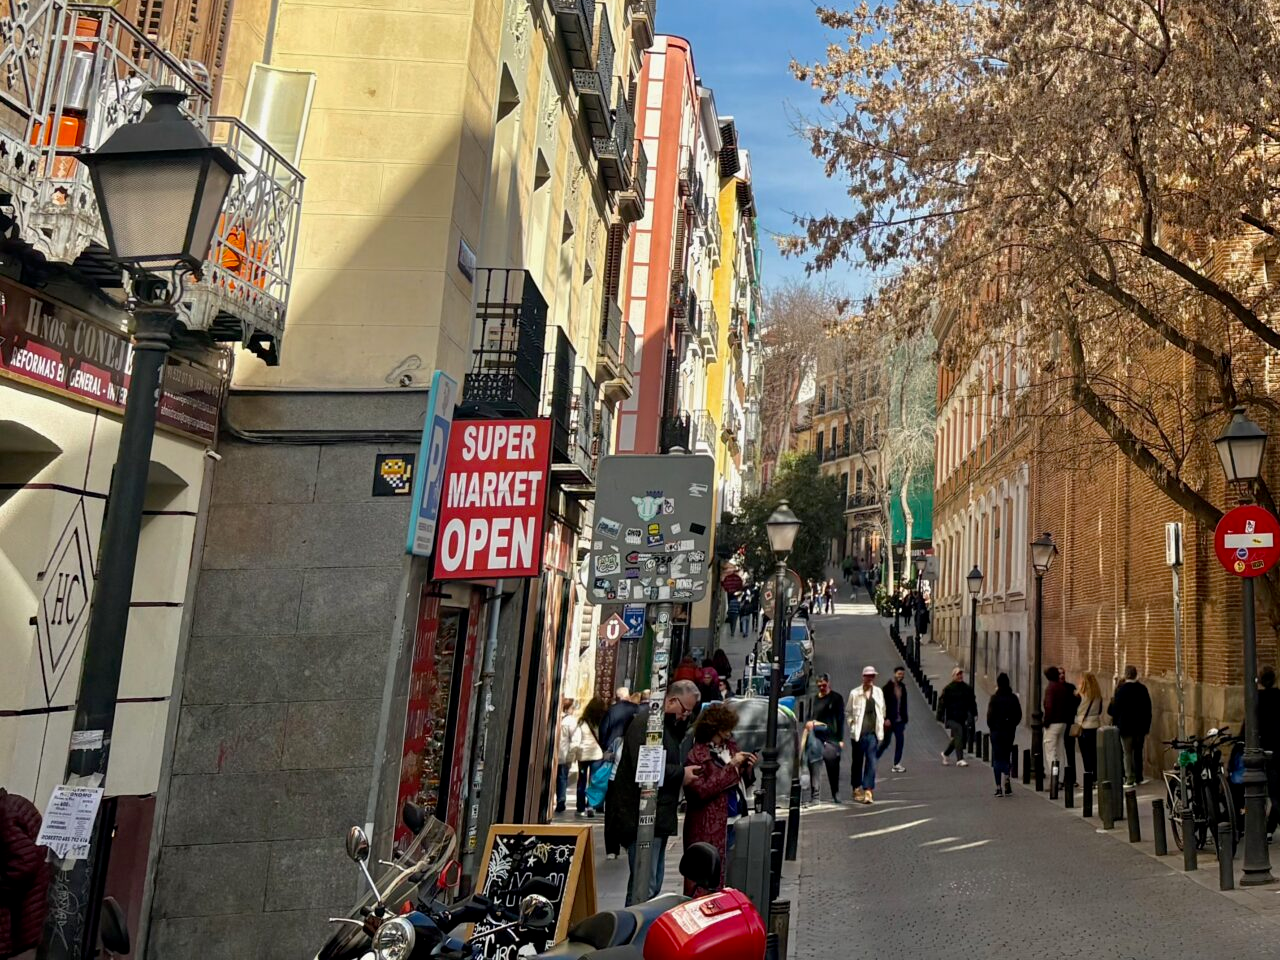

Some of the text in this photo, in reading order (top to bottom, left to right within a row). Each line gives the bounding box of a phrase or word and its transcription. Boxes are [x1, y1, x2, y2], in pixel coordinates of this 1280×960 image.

[10, 346, 56, 380] REFORMAS
[56, 363, 68, 383] EN
[70, 368, 101, 395] GENERAL
[422, 424, 444, 509] P
[462, 425, 536, 461] SUPER
[447, 471, 542, 508] MARKET
[441, 517, 536, 571] OPEN
[51, 573, 79, 625] HC
[606, 619, 620, 640] Ü
